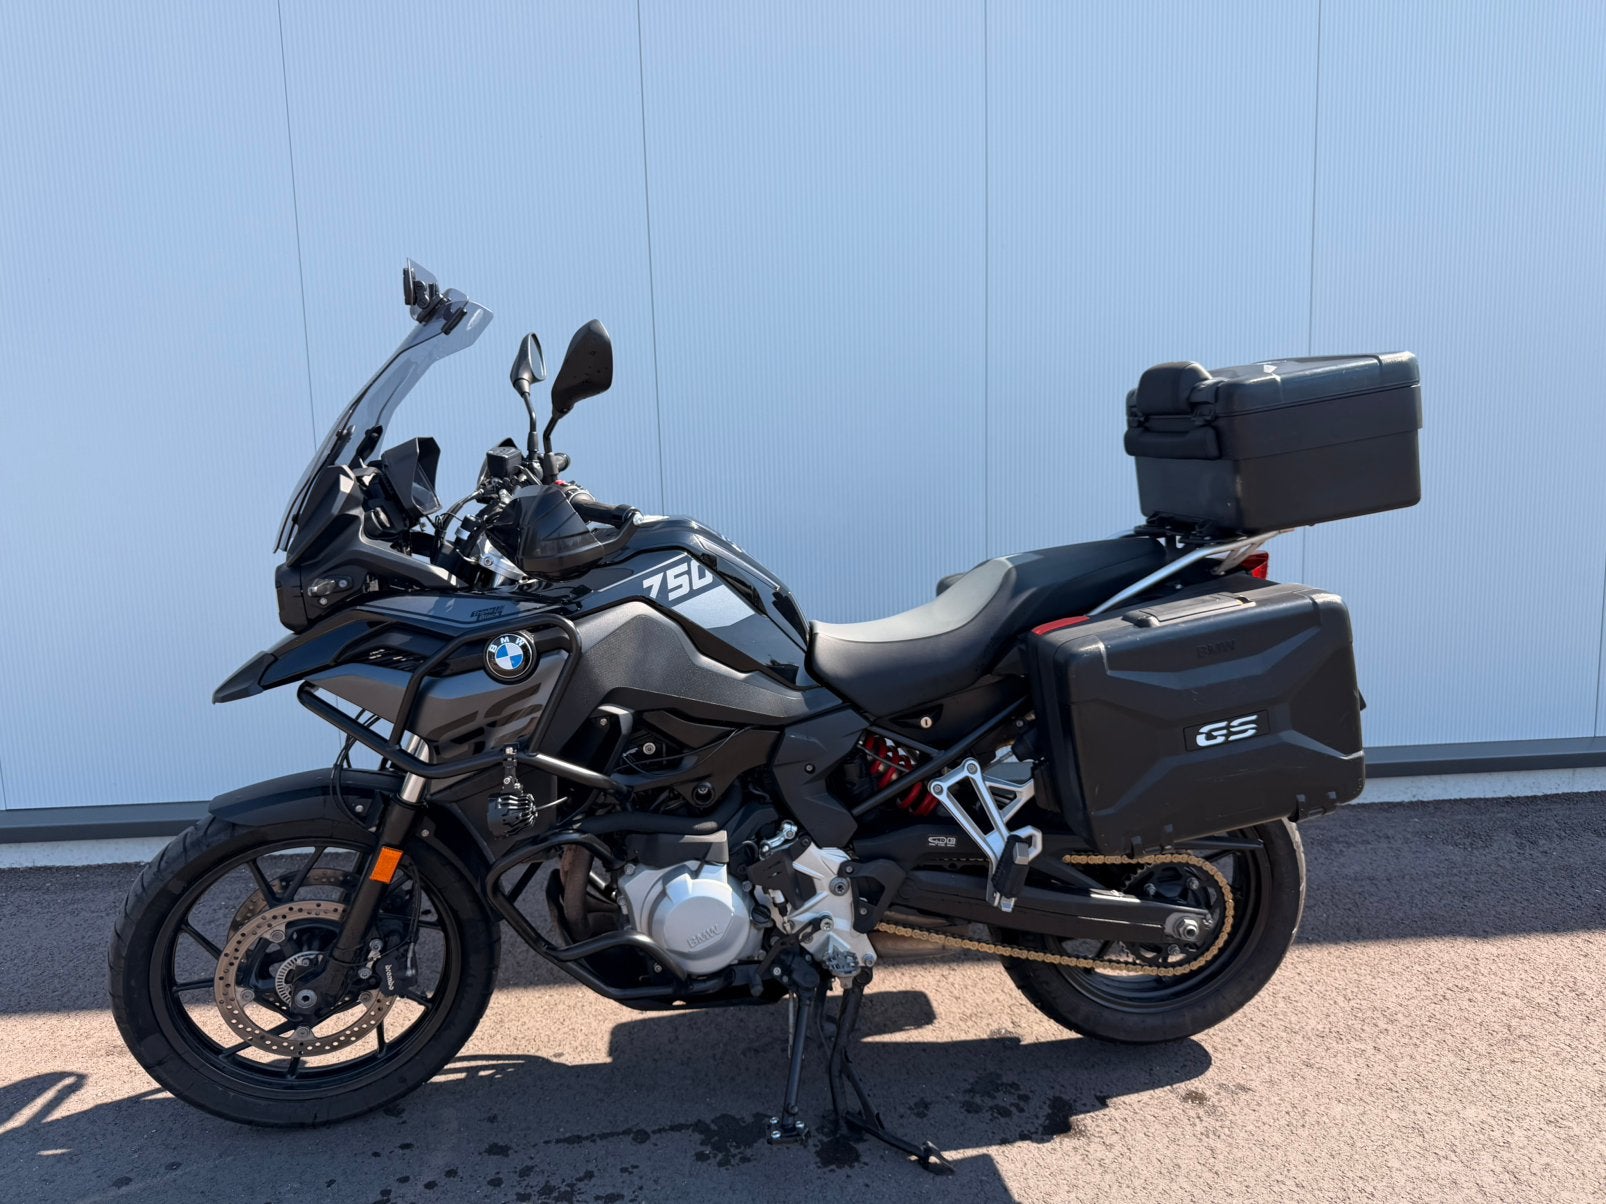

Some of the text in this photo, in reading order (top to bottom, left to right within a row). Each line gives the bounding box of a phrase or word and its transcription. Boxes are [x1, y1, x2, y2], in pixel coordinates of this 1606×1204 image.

[642, 559, 713, 601] 750
[488, 635, 525, 653] BMW
[1196, 714, 1258, 747] GS
[687, 923, 721, 949] BMW
